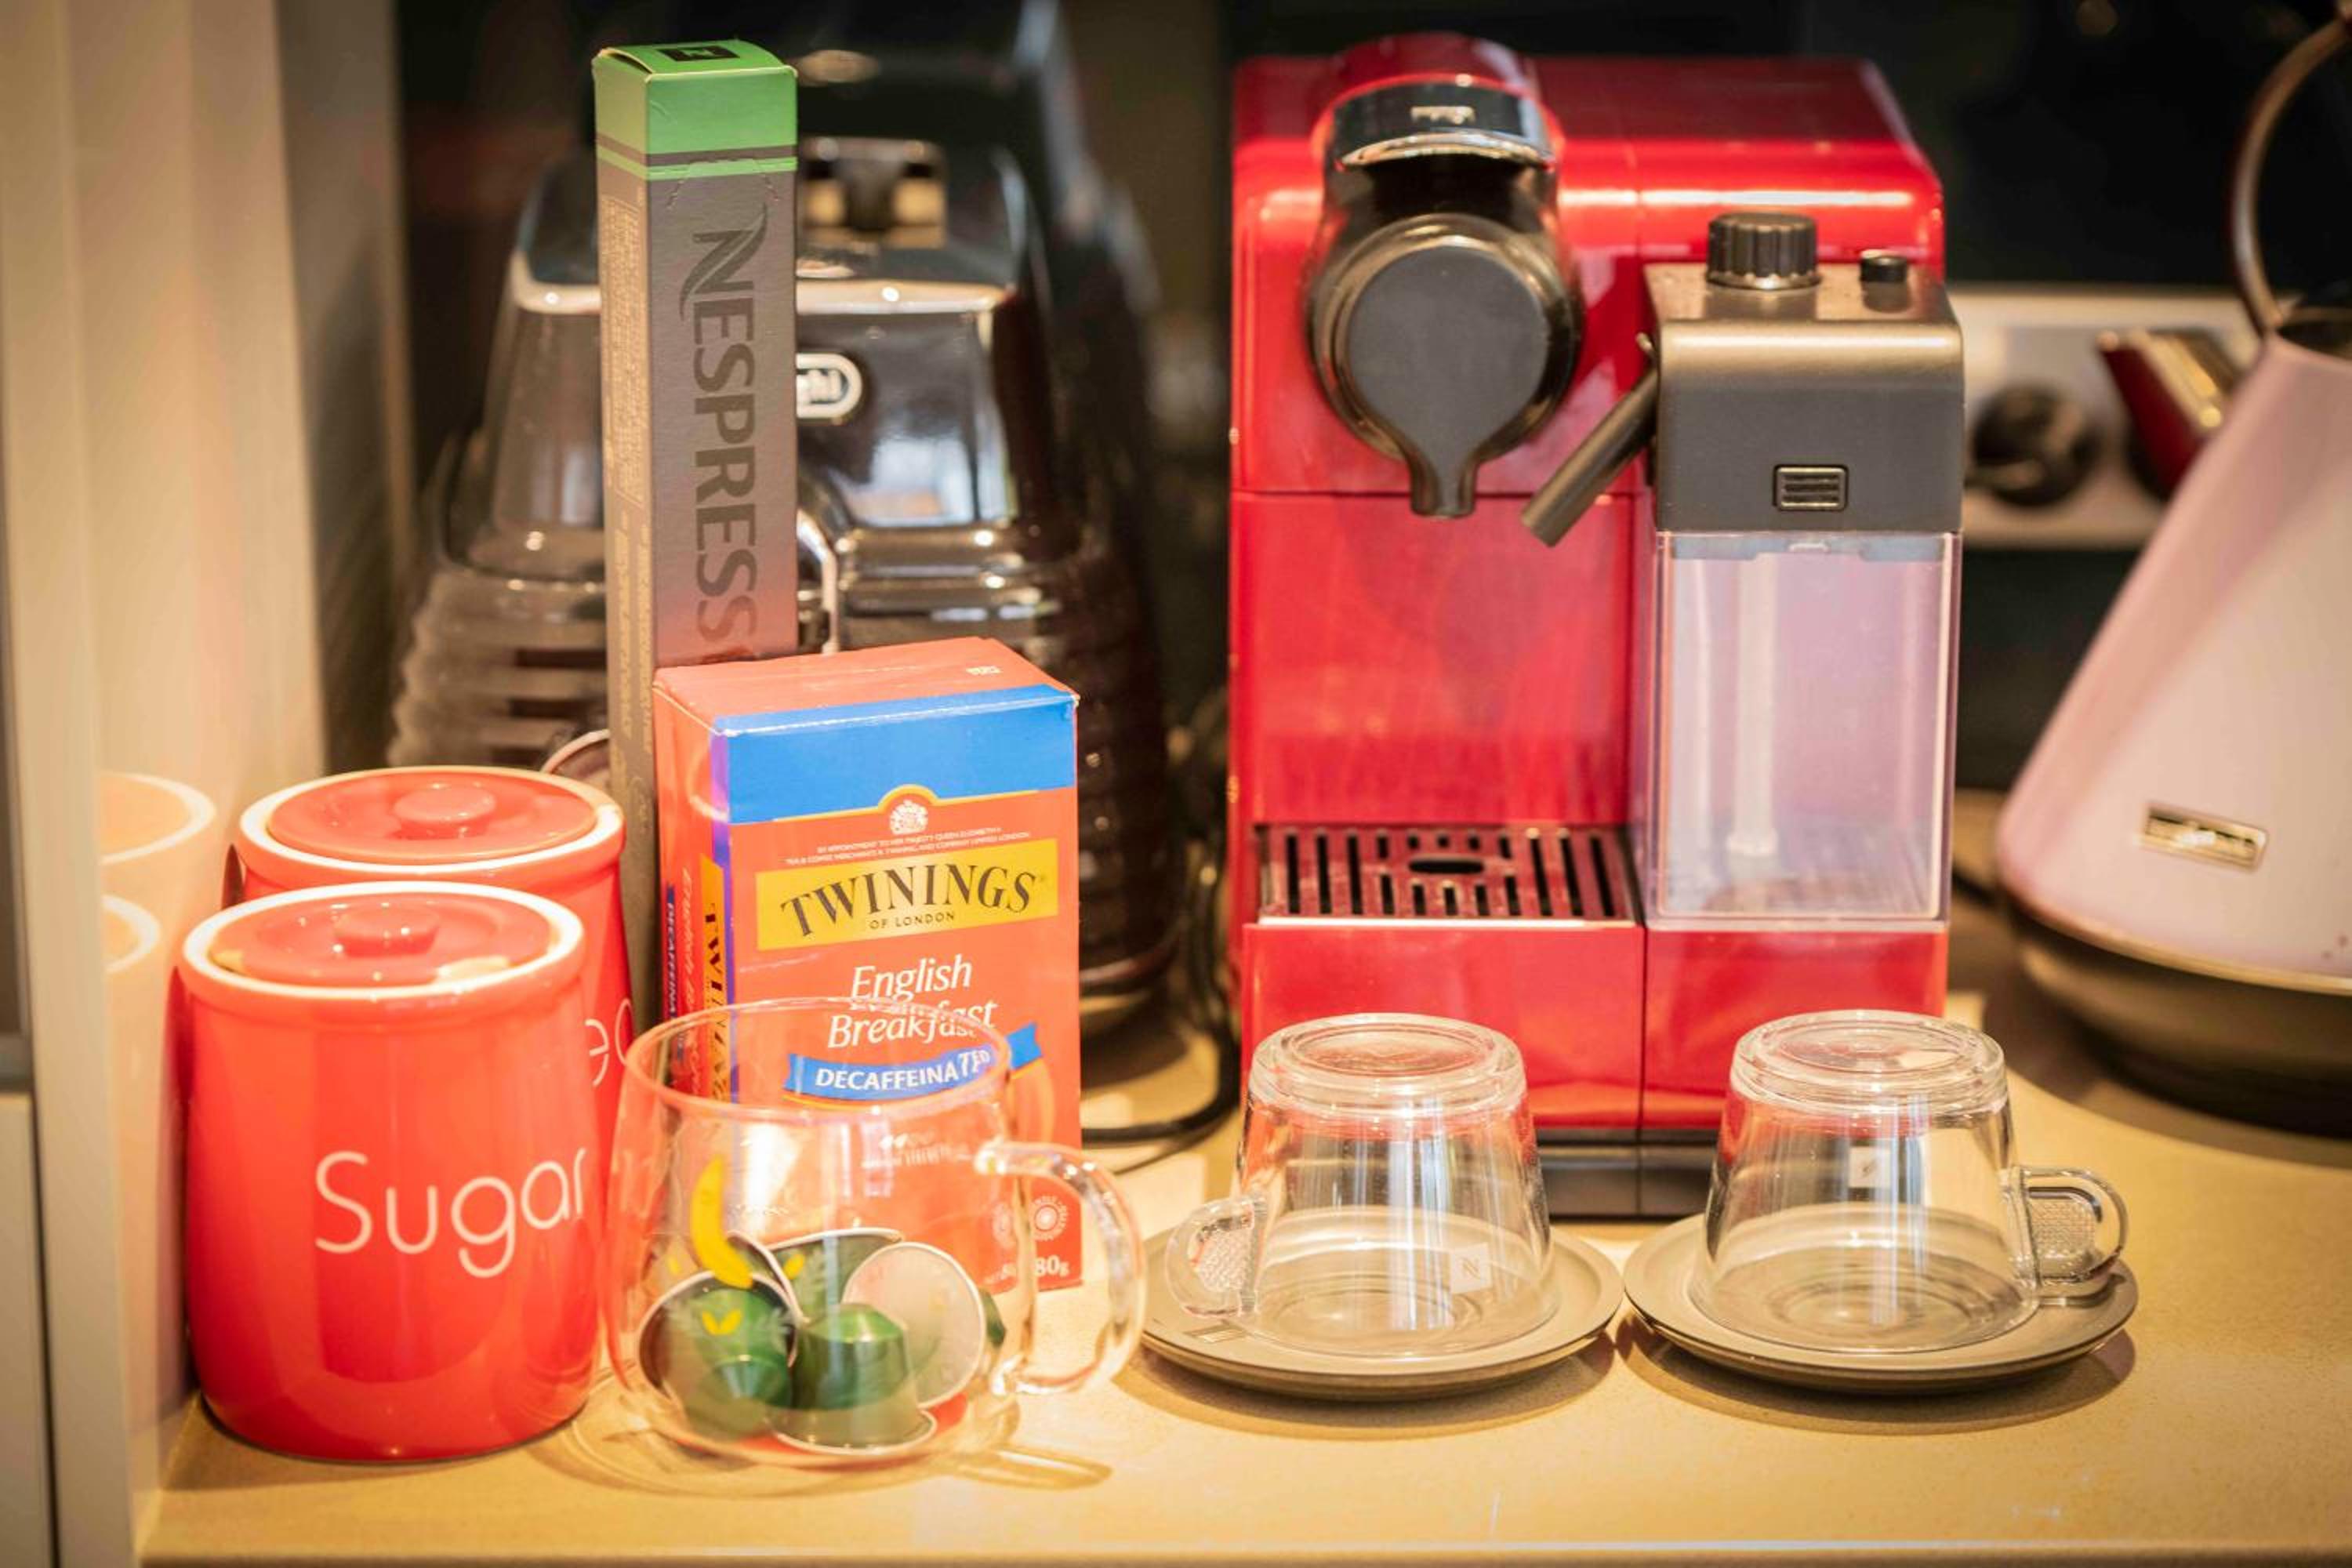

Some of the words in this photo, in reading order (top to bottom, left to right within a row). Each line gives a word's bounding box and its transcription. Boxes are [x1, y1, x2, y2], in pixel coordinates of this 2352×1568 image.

[680, 201, 768, 659] NESPRESS
[780, 863, 1036, 937] TWININGS
[869, 919, 888, 931] OF
[895, 912, 956, 927] LONDON
[851, 953, 973, 1003] English
[815, 1049, 991, 1091] DECAFFEINATED
[315, 1147, 586, 1279] Sugar
